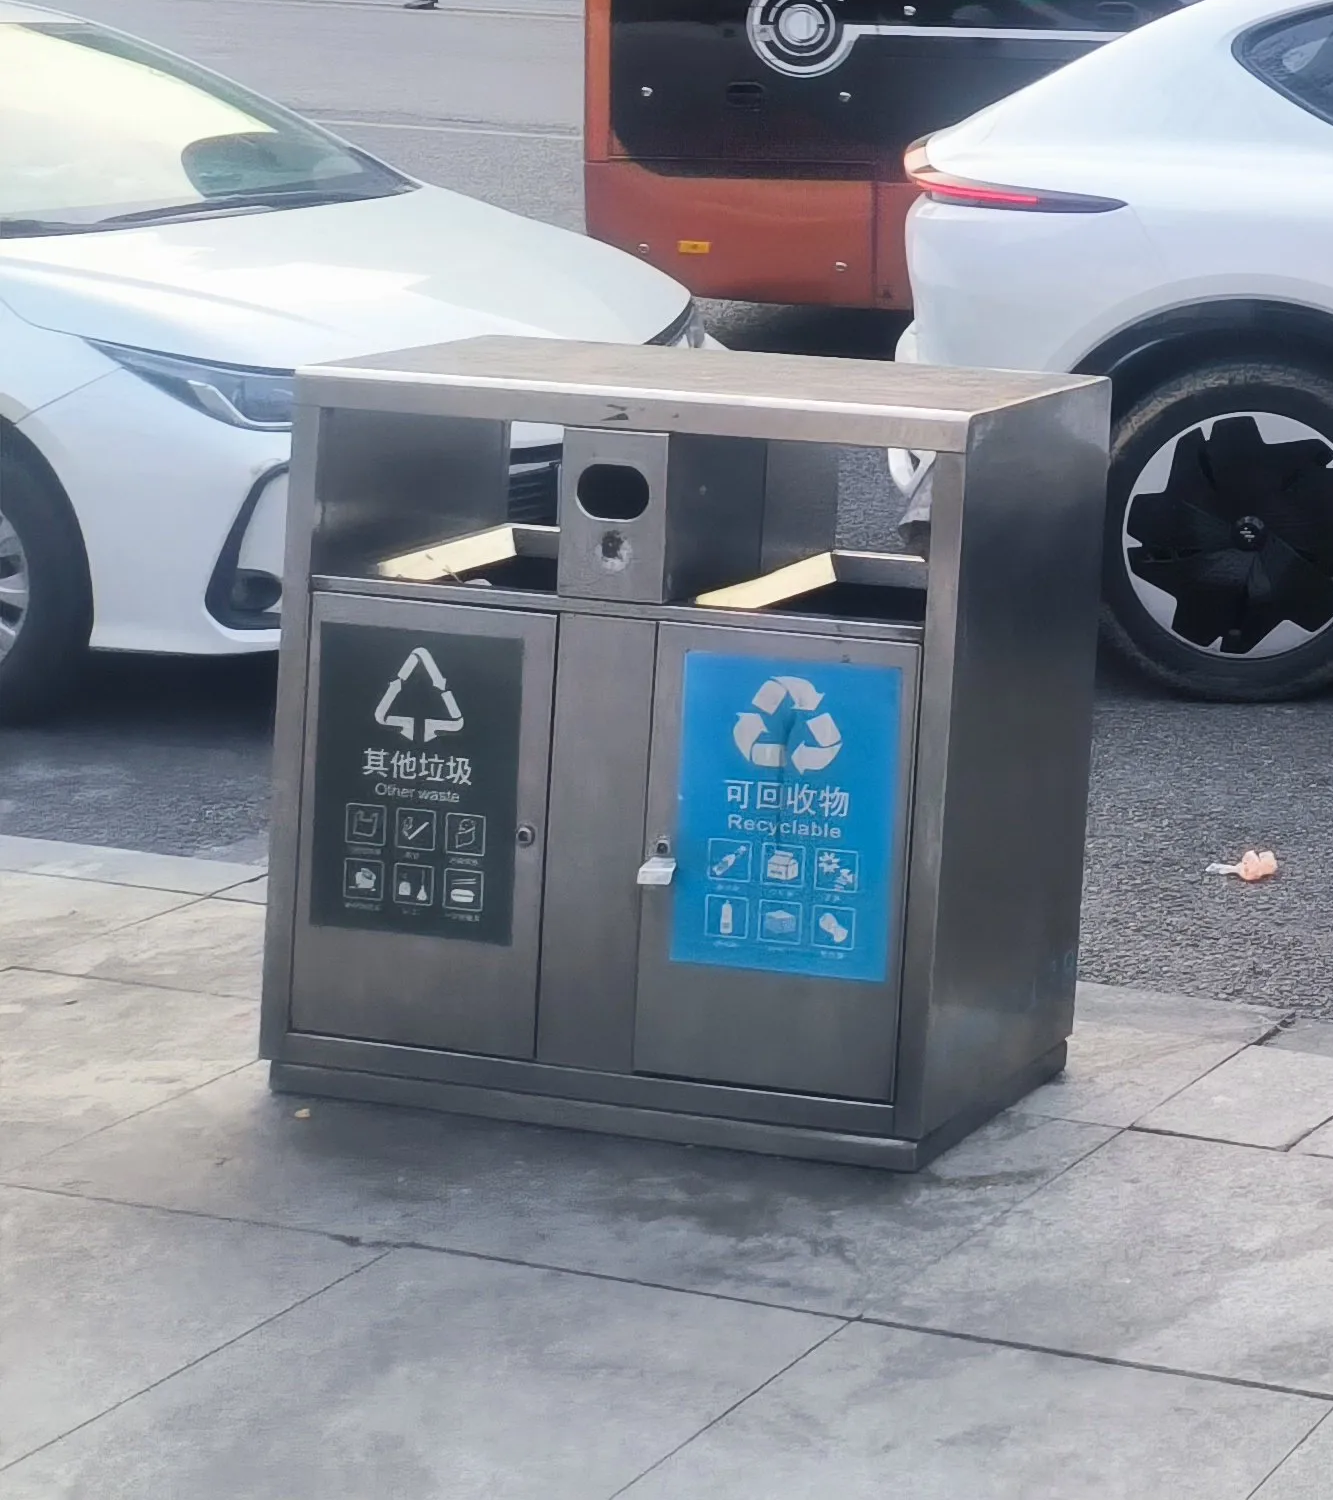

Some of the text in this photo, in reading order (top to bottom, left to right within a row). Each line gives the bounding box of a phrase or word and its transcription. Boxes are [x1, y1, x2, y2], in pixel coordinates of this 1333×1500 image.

[361, 747, 473, 786] 其他垃圾
[374, 782, 461, 803] Other waste
[723, 779, 851, 818] 可回收物
[727, 813, 842, 839] Recyclable
